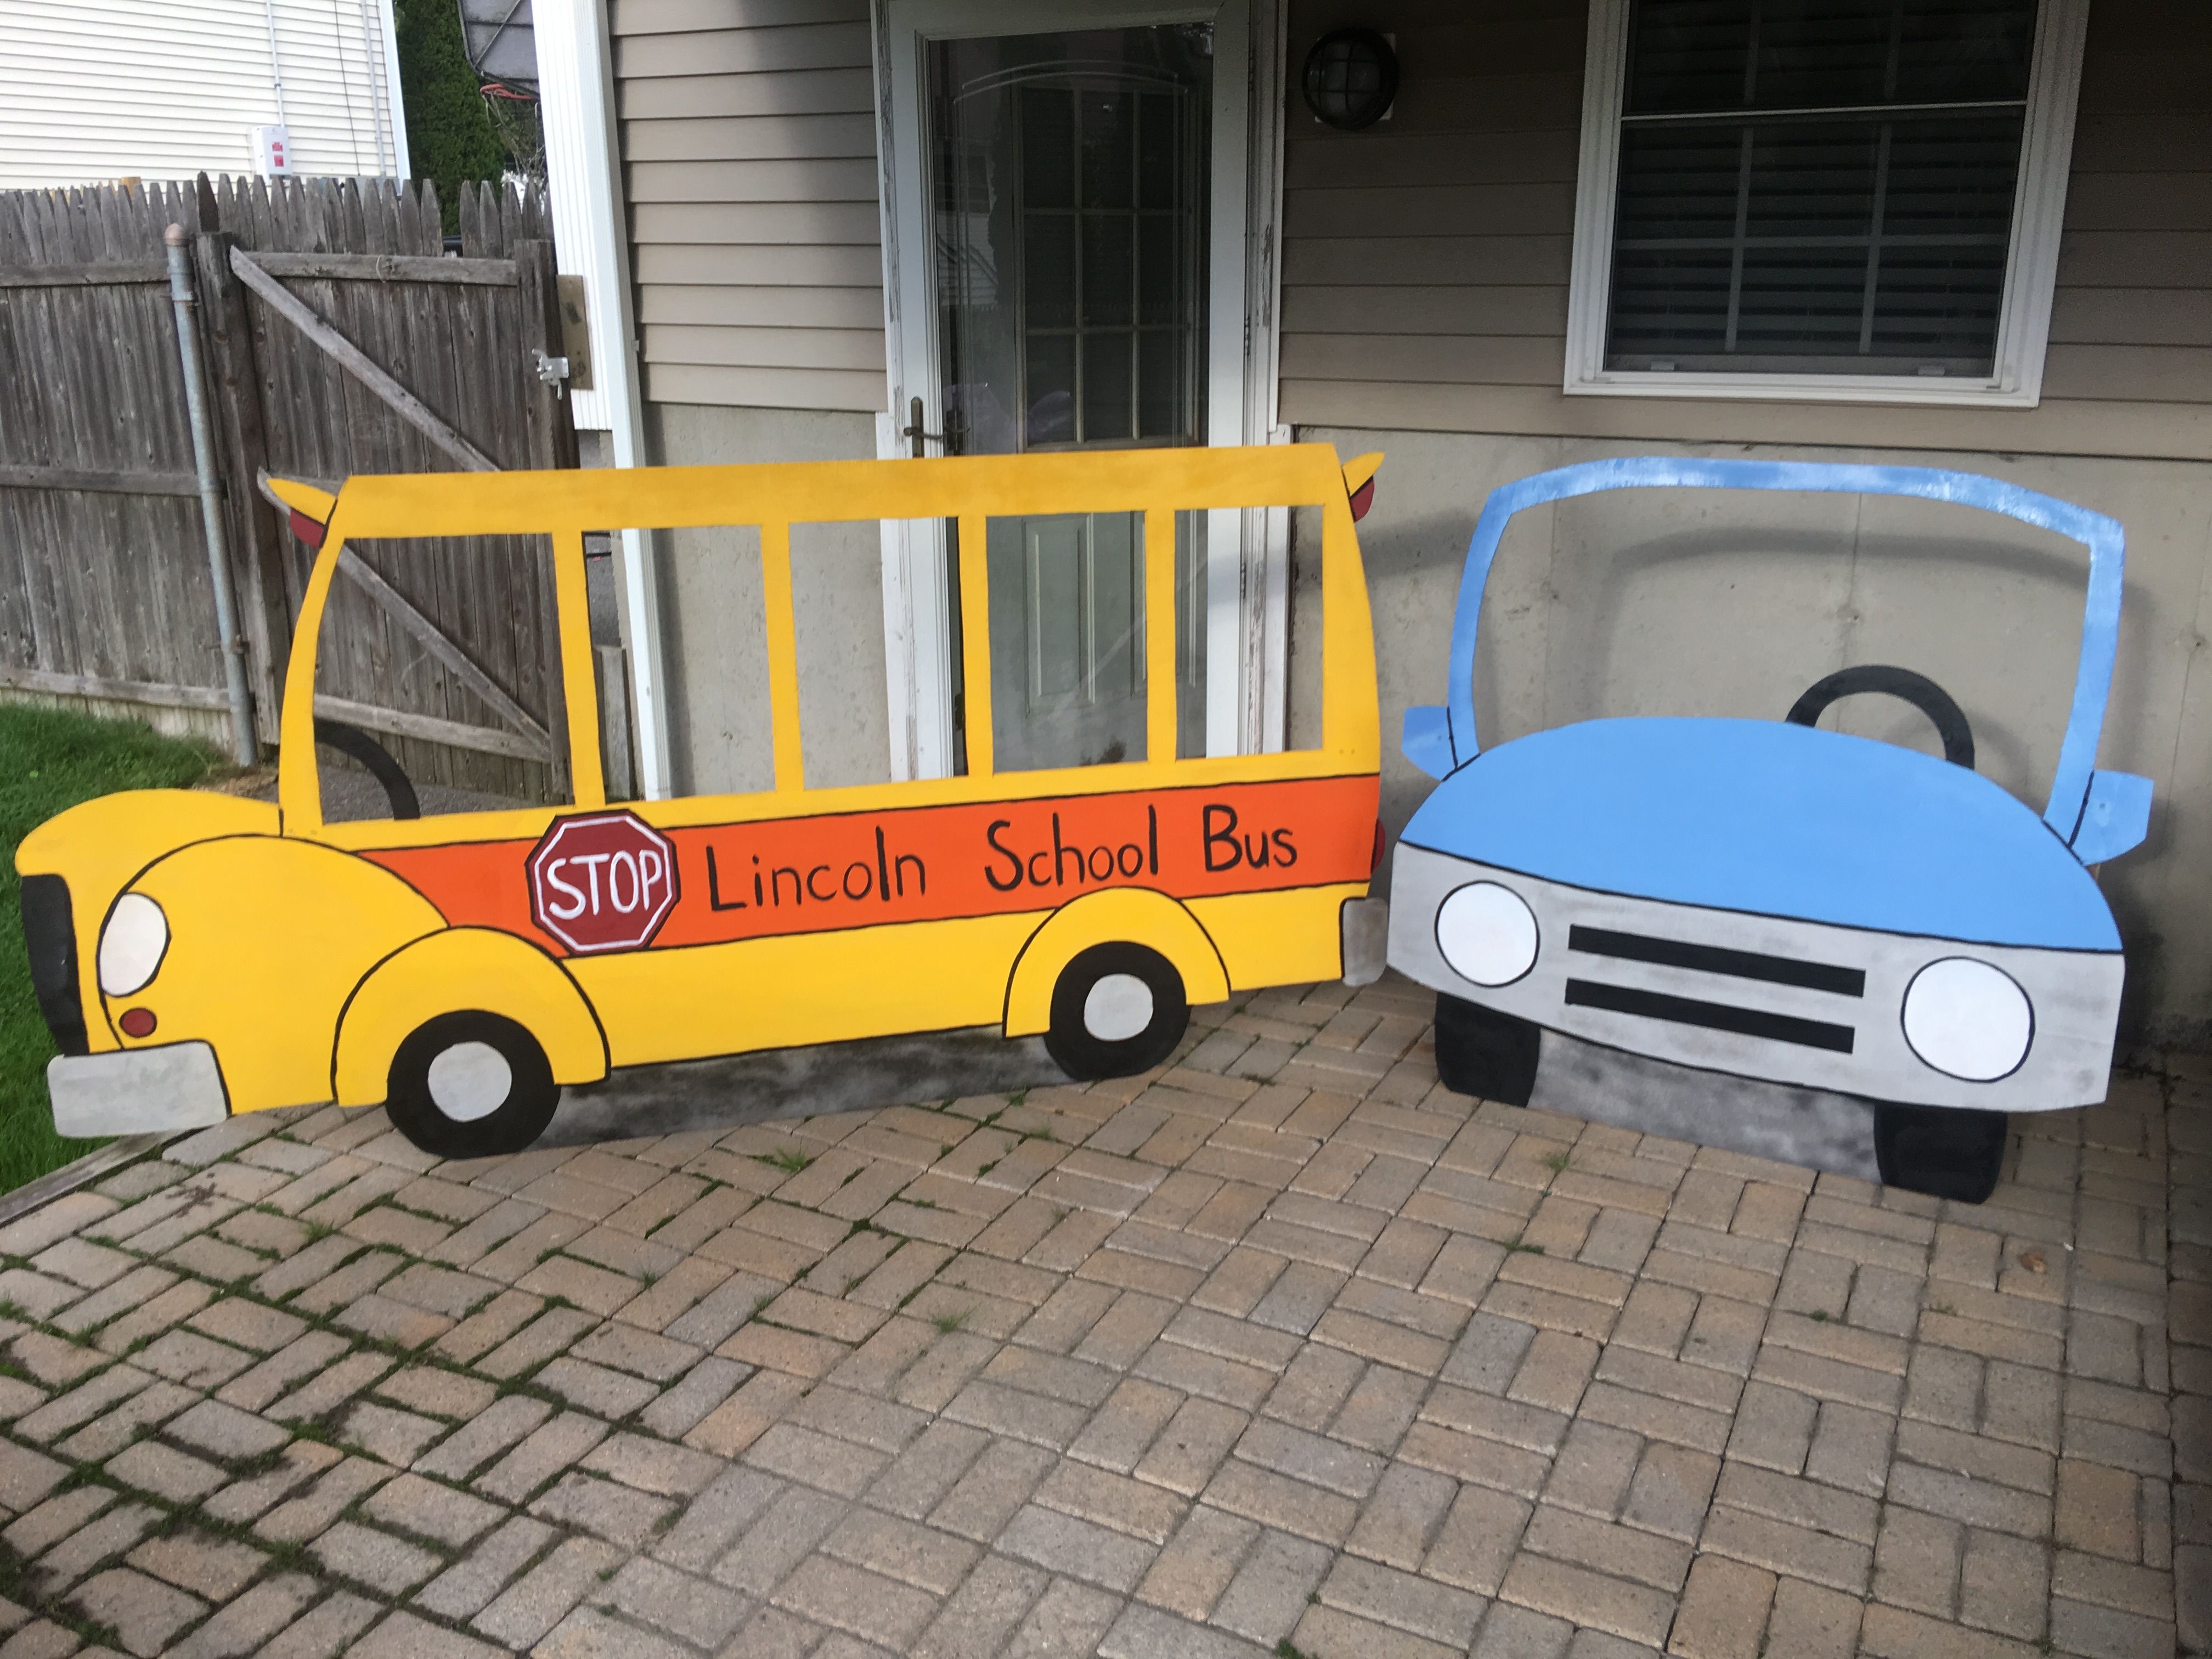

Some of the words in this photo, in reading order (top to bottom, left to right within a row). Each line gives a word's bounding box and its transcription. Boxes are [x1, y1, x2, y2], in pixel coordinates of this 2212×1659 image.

[546, 849, 662, 920] STOP
[706, 825, 927, 911] Lincoln
[985, 803, 1159, 891] School
[1203, 804, 1297, 872] Bus
